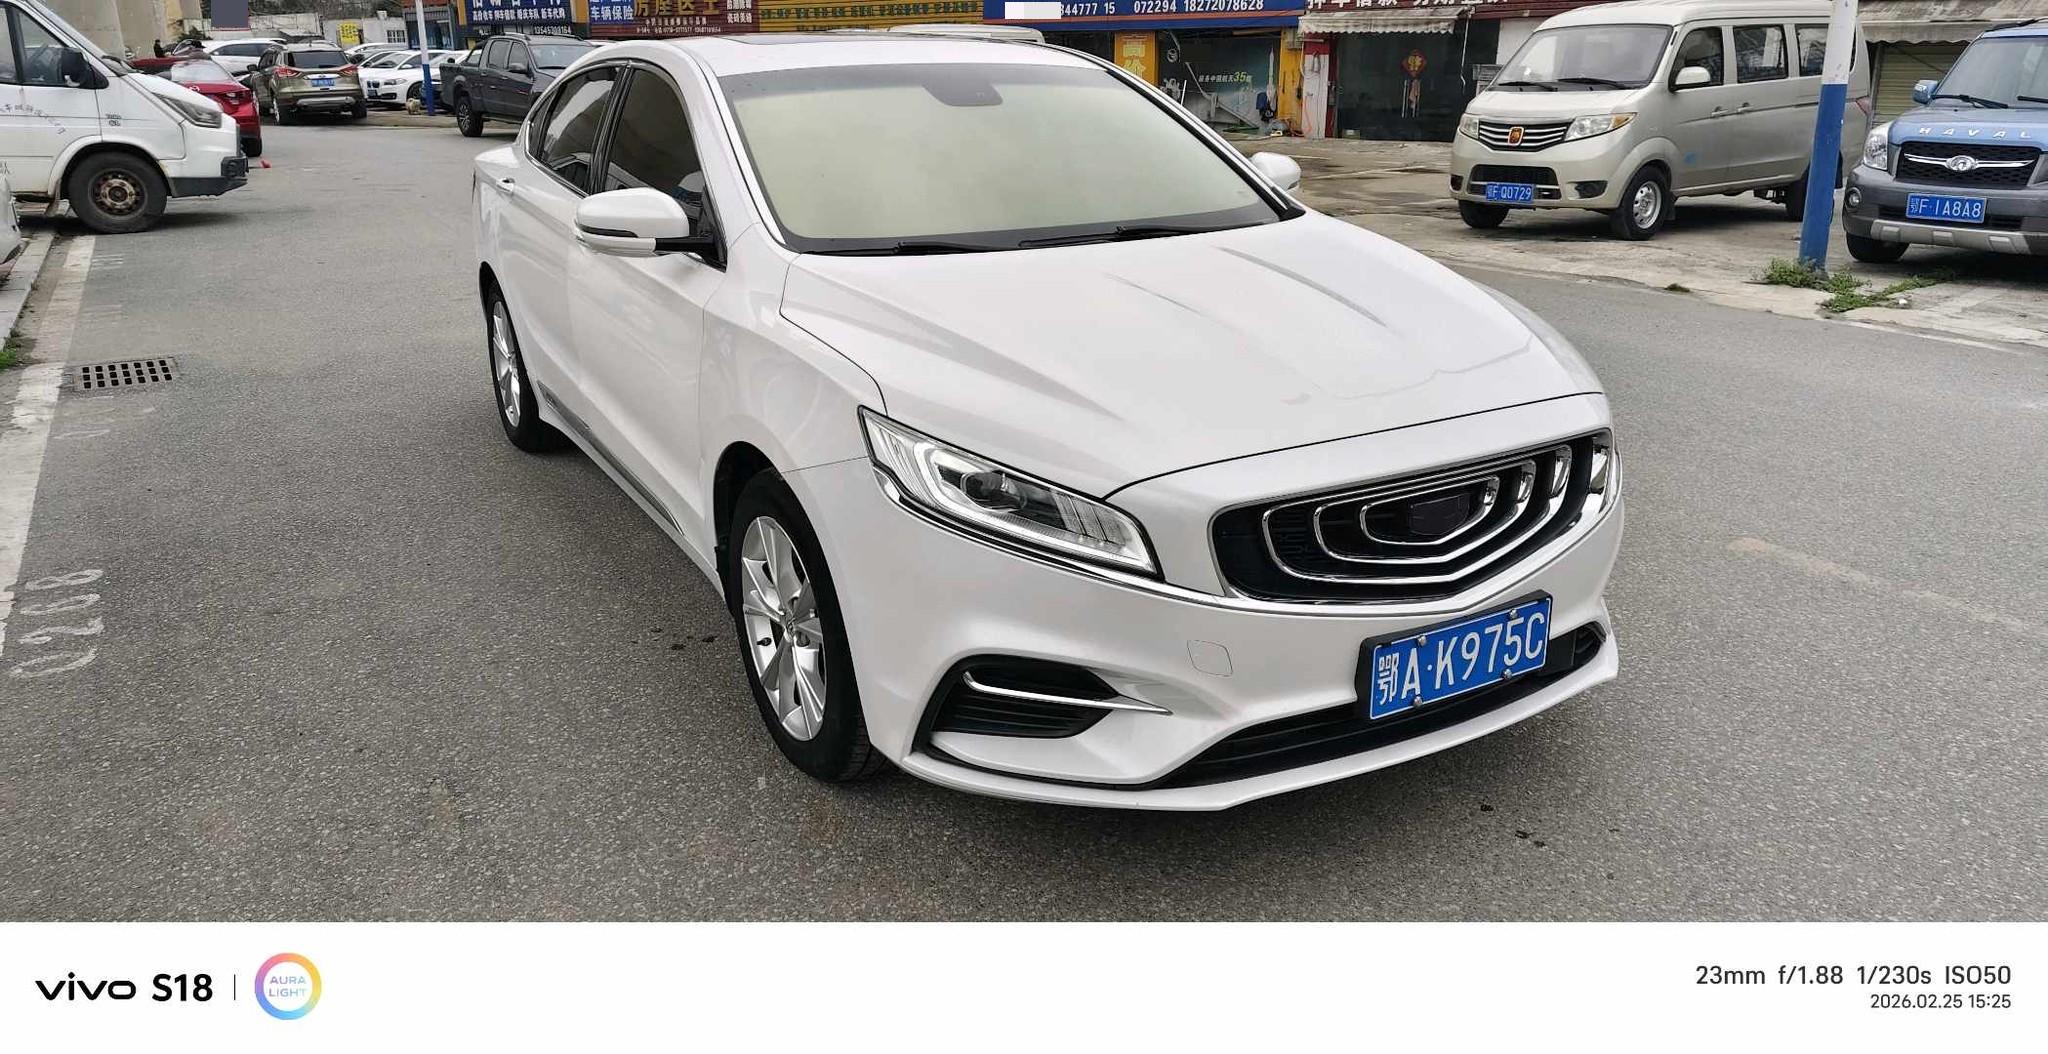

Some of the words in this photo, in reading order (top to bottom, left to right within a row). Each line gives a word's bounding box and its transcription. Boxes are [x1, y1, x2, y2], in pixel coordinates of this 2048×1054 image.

[590, 5, 634, 21] 车辆保险
[1919, 127, 2031, 139] HAVAL
